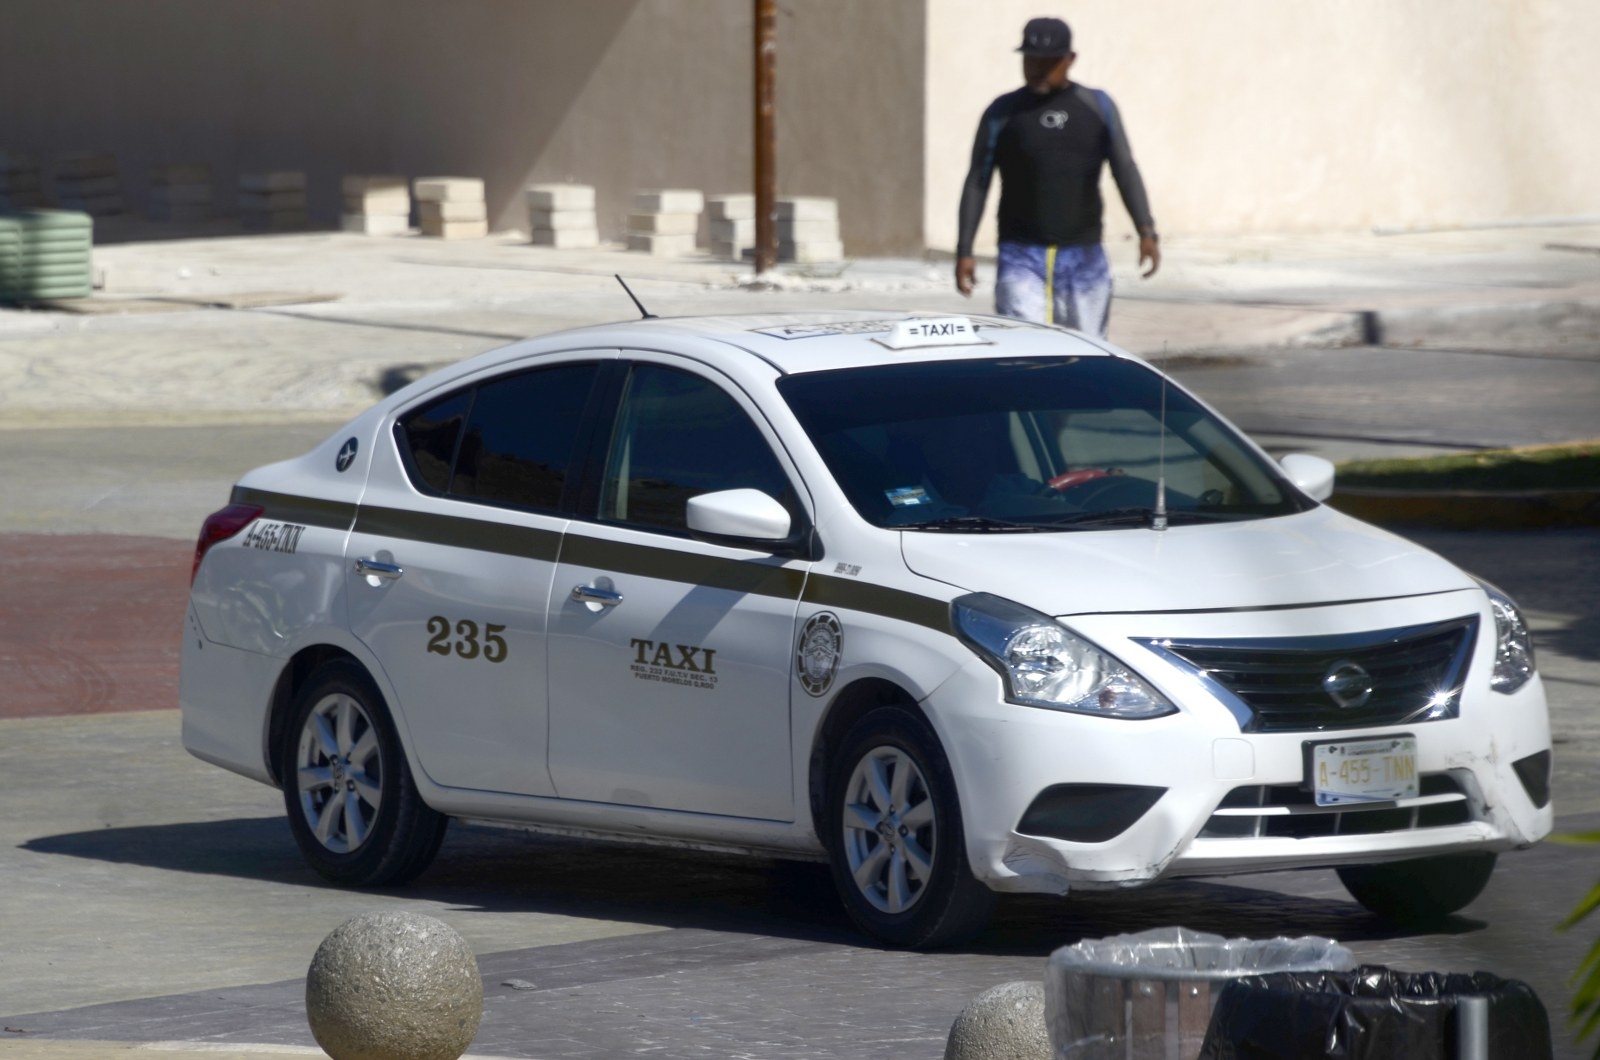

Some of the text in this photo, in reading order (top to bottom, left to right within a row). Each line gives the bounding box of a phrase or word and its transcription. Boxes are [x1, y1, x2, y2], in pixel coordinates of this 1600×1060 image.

[427, 615, 508, 663] 235
[630, 638, 717, 674] TAXI
[634, 672, 660, 682] PUERTO
[661, 676, 692, 687] MORELOS
[1319, 755, 1416, 787] A-455-TNN
